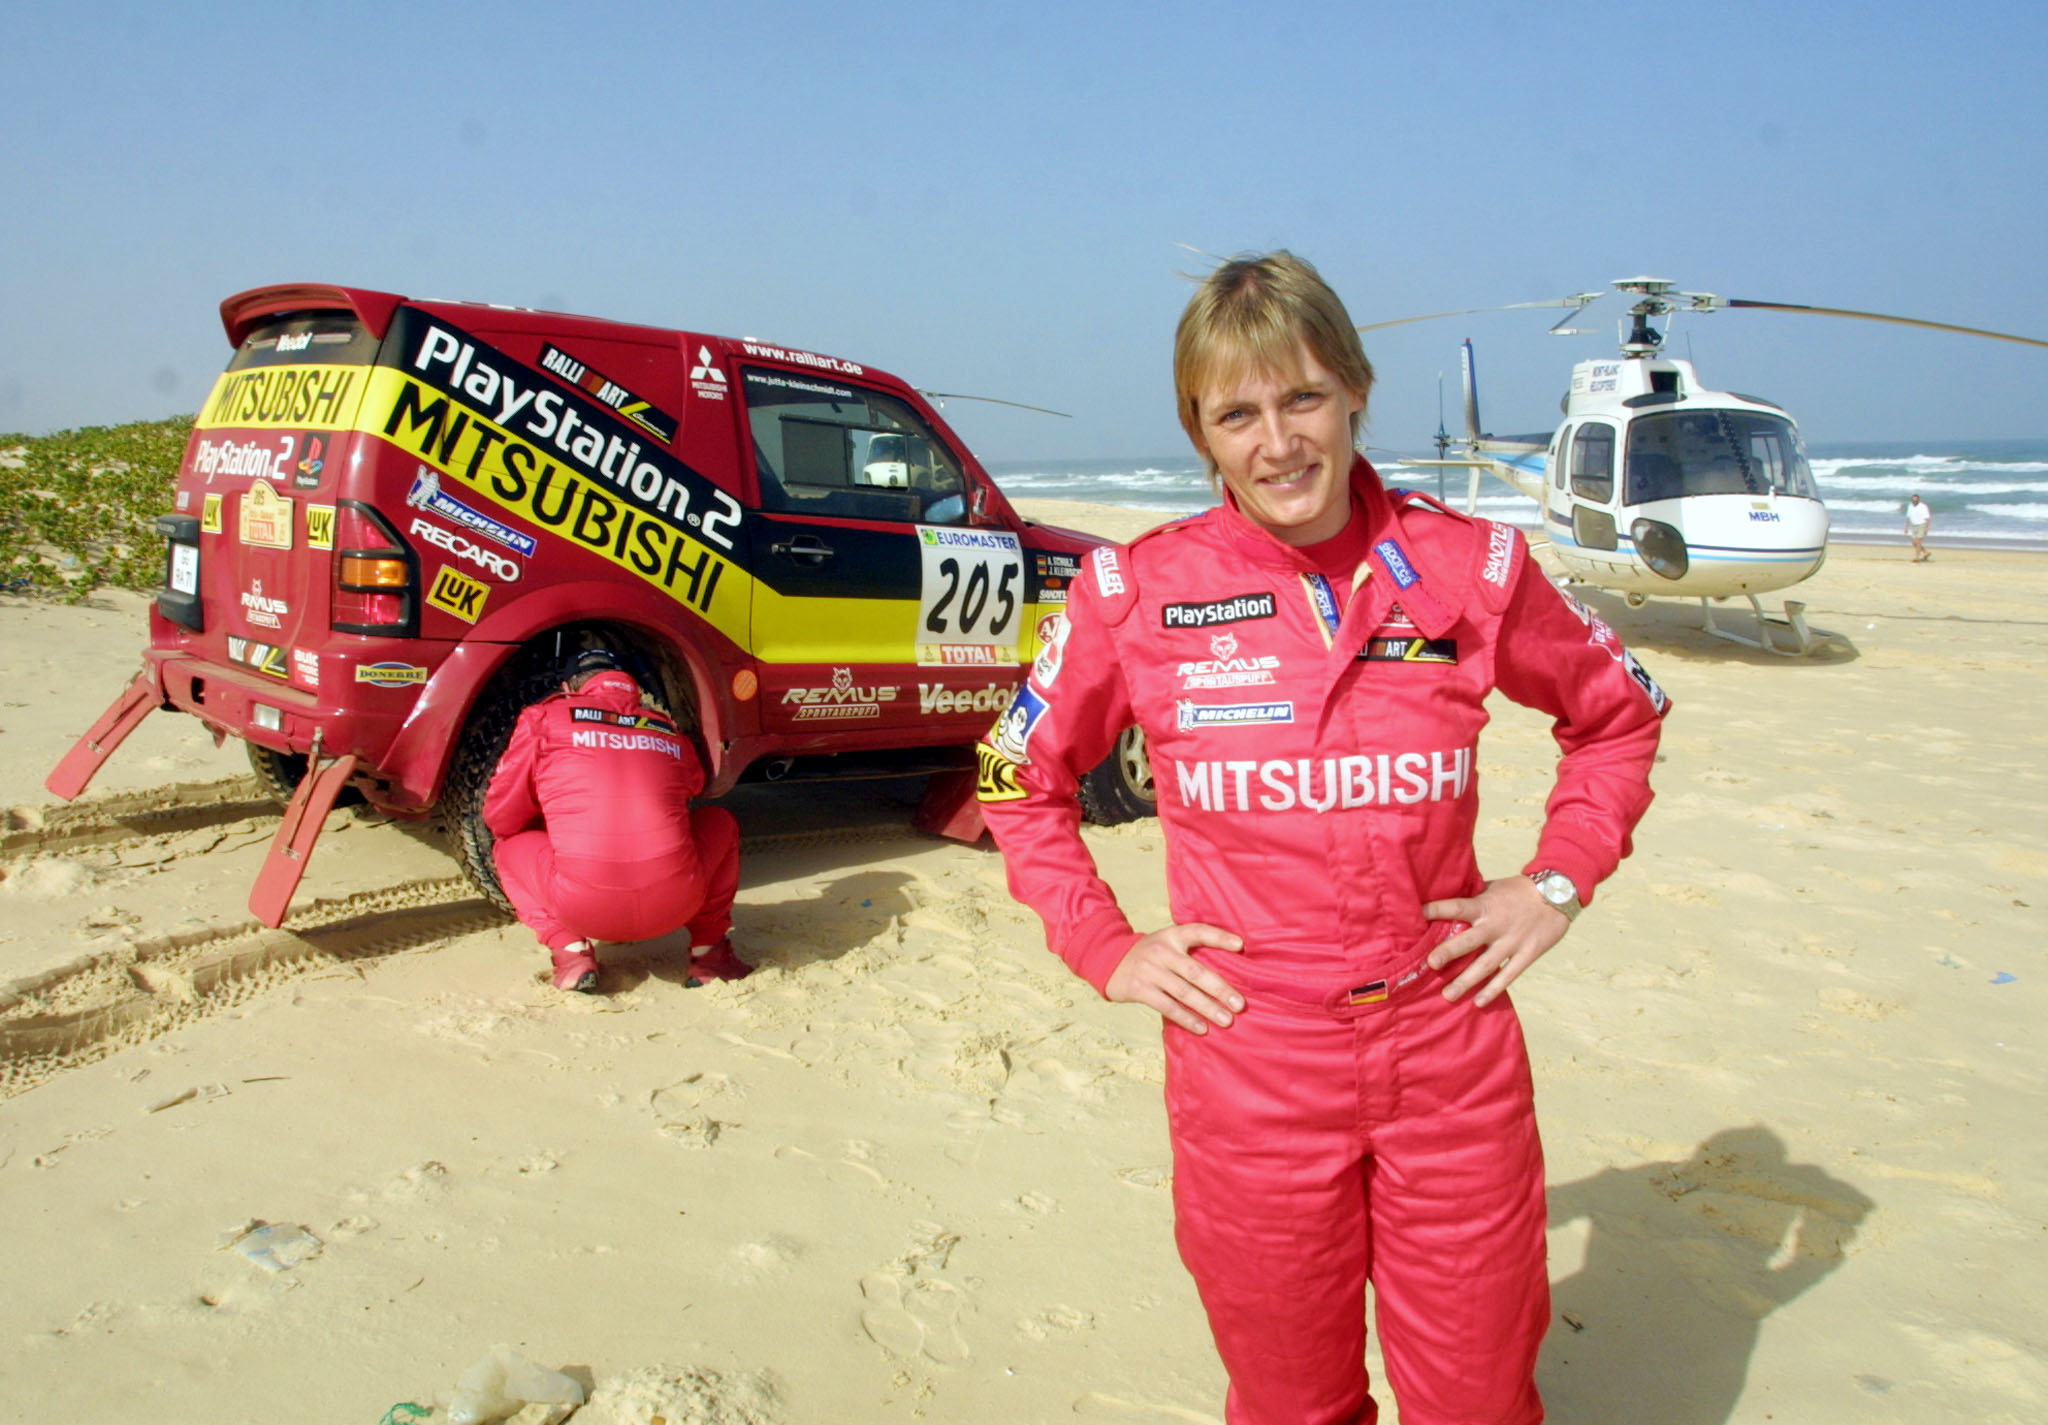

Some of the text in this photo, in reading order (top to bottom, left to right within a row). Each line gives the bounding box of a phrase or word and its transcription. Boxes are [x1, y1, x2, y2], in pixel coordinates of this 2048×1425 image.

[542, 347, 629, 409] RALLI ART
[743, 343, 863, 375] www.ralliart.de
[211, 370, 355, 424] MITSUBISHI
[414, 325, 691, 521] PlayStation
[193, 440, 272, 485] PlayStation
[383, 380, 725, 614] MITSUBISHI
[434, 497, 532, 549] MICHELIN
[1748, 511, 1781, 523] MBH
[410, 518, 520, 582] RECARO
[936, 531, 1018, 550] EUROMASTER
[1483, 522, 1509, 583] SANDTLE
[434, 572, 483, 616] LUK
[926, 557, 1019, 636] 205
[1165, 598, 1272, 626] PlayStation
[941, 646, 995, 664] TOTAL
[1176, 656, 1281, 677] REMUS
[1385, 641, 1407, 656] ART
[781, 687, 897, 704] REMUS
[1197, 706, 1289, 721] MICHELIN
[574, 709, 636, 726] RALLI ART
[572, 731, 681, 760] MITSUBISHI
[1174, 747, 1471, 814] MITSUBISHI
